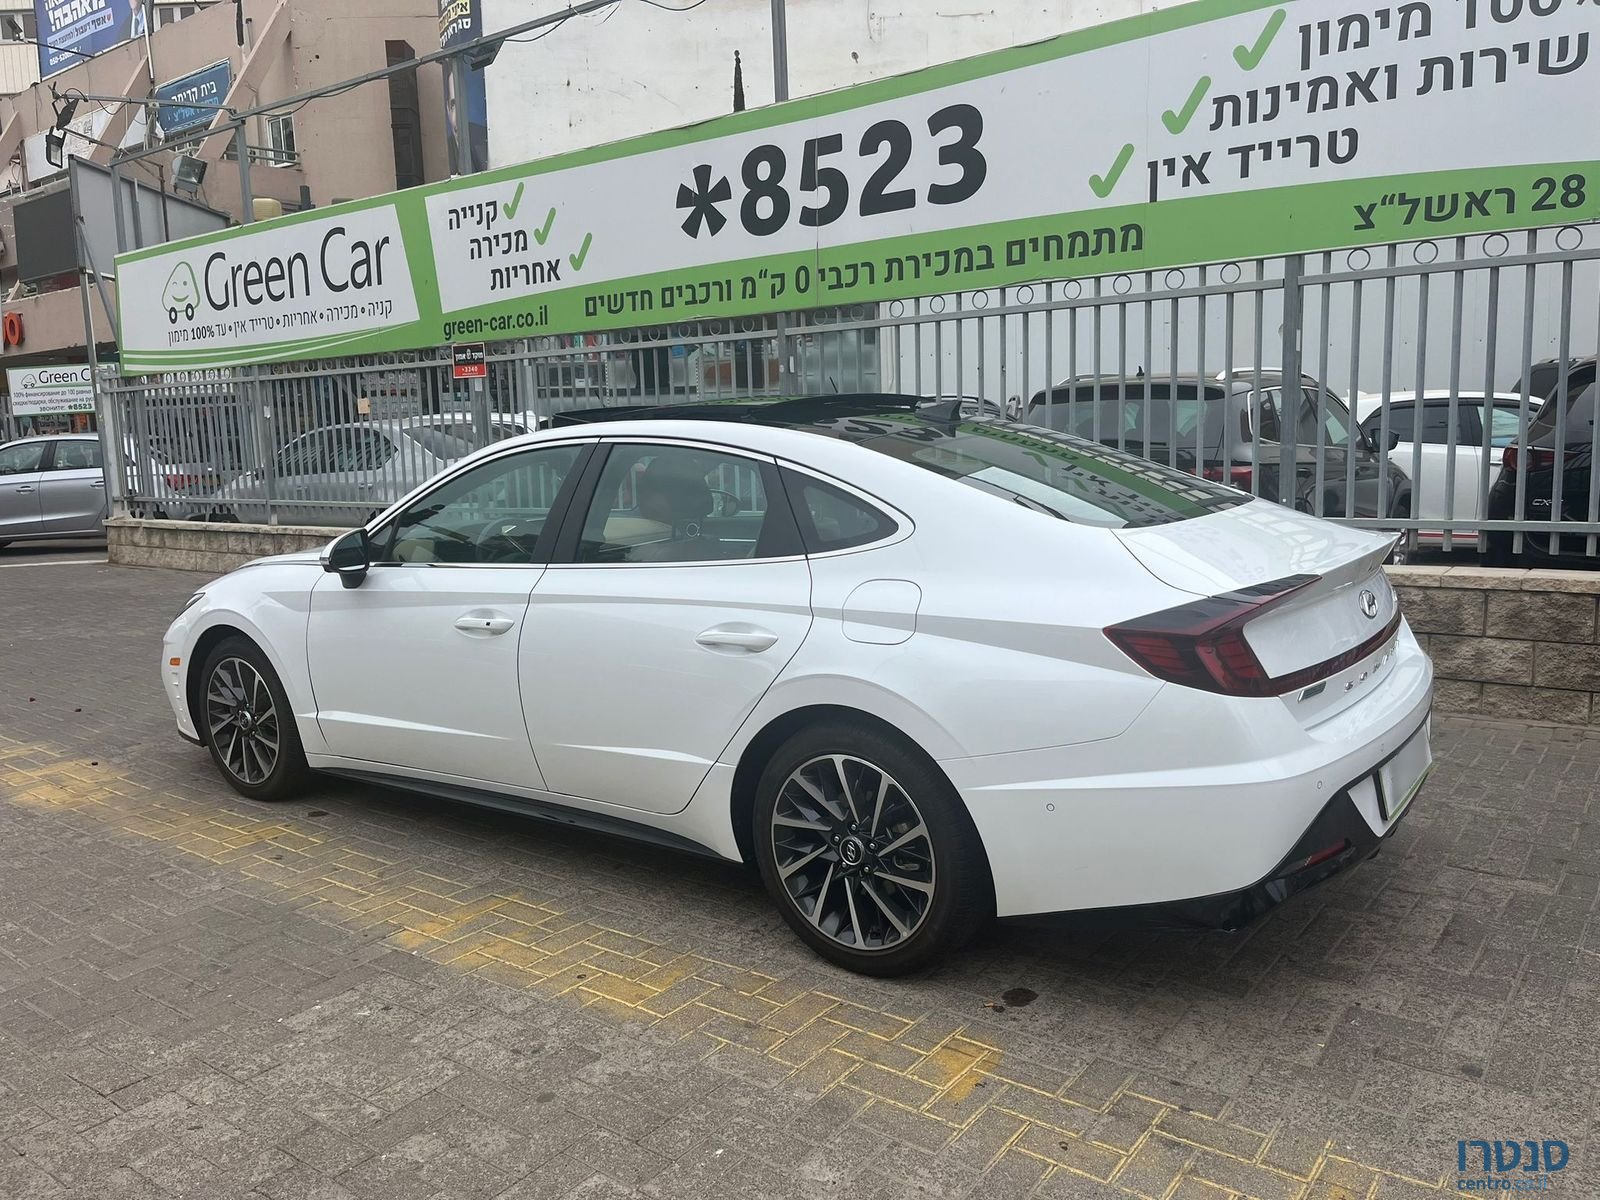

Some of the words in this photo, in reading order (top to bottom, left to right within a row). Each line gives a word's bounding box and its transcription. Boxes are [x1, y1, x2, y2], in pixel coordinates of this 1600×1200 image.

[1299, 2, 1431, 71] מימון
[1416, 31, 1590, 97] שירות
[200, 81, 217, 98] בית
[1209, 63, 1398, 132] ואמינות
[1227, 127, 1359, 180] טרייד
[1147, 151, 1211, 204] אין
[1531, 174, 1586, 211] 28
[448, 200, 498, 231] קנייה
[1353, 186, 1516, 231] ראשל"צ
[469, 229, 529, 260] מכירה
[1006, 223, 1143, 267] מתמחים
[204, 251, 311, 311] Green
[320, 226, 390, 293] Car
[490, 258, 561, 291] אחריות
[818, 261, 875, 291] רכבי
[884, 244, 995, 283] במכירת
[661, 279, 732, 309] ורכבים
[741, 268, 786, 300] ק"מ
[795, 265, 810, 294] 0
[326, 303, 359, 322] מכירה
[368, 300, 393, 320] קניה
[584, 288, 653, 317] חדשים
[191, 324, 215, 340] 100%
[215, 322, 227, 336] עד
[233, 321, 247, 338] אין
[249, 315, 274, 331] טרייד
[282, 309, 318, 328] אחריות
[443, 305, 548, 341] green-car.co.il
[168, 328, 189, 347] מימון
[38, 369, 78, 384] Green
